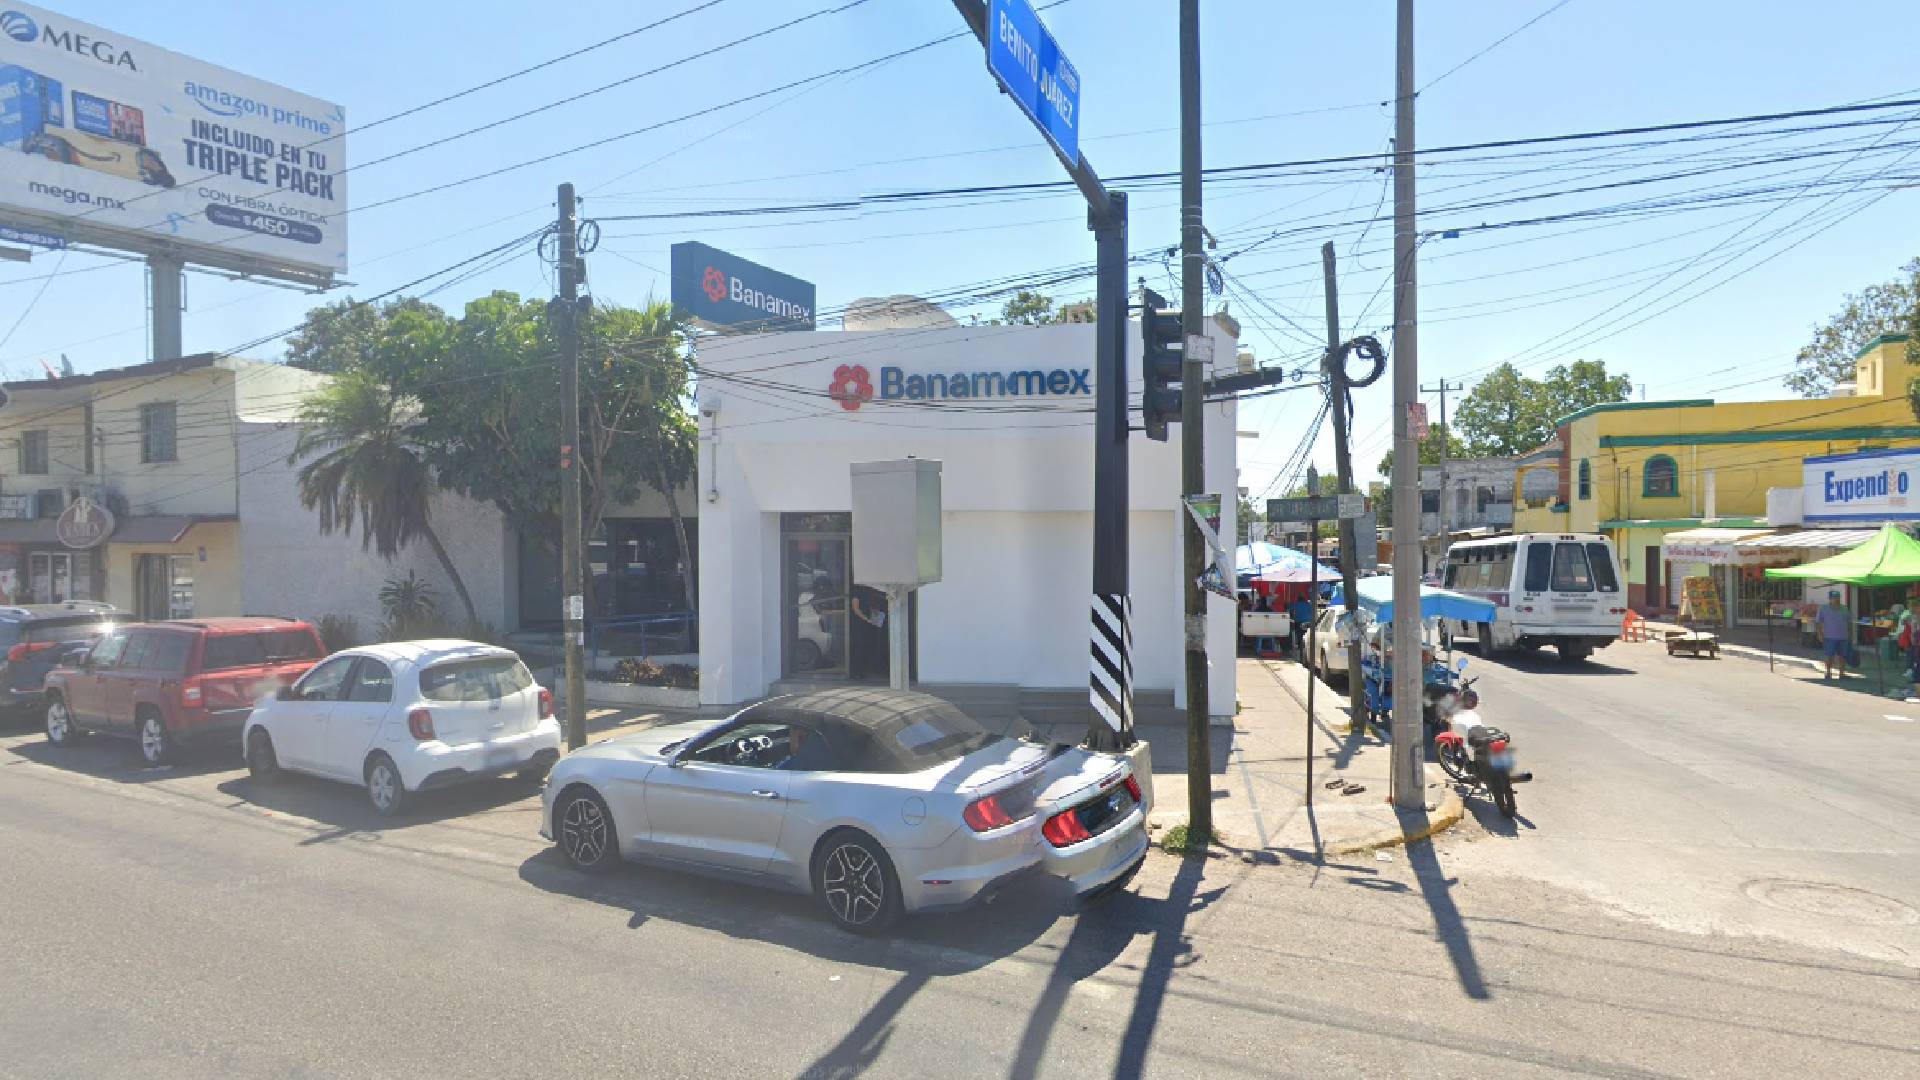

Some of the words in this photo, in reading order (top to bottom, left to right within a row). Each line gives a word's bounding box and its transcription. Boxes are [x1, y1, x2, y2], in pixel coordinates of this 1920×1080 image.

[43, 24, 137, 71] MEGA
[1000, 10, 1038, 83] BENITO
[184, 81, 269, 118] amazon
[272, 106, 331, 135] prime
[182, 137, 268, 185] TRIPLE
[275, 163, 333, 201] PACK
[191, 118, 275, 158] INCLUIDO
[281, 141, 301, 164] EN
[307, 150, 326, 171] TU
[29, 181, 126, 211] mega.mx
[199, 187, 231, 203] CON
[730, 276, 811, 324] Banamex
